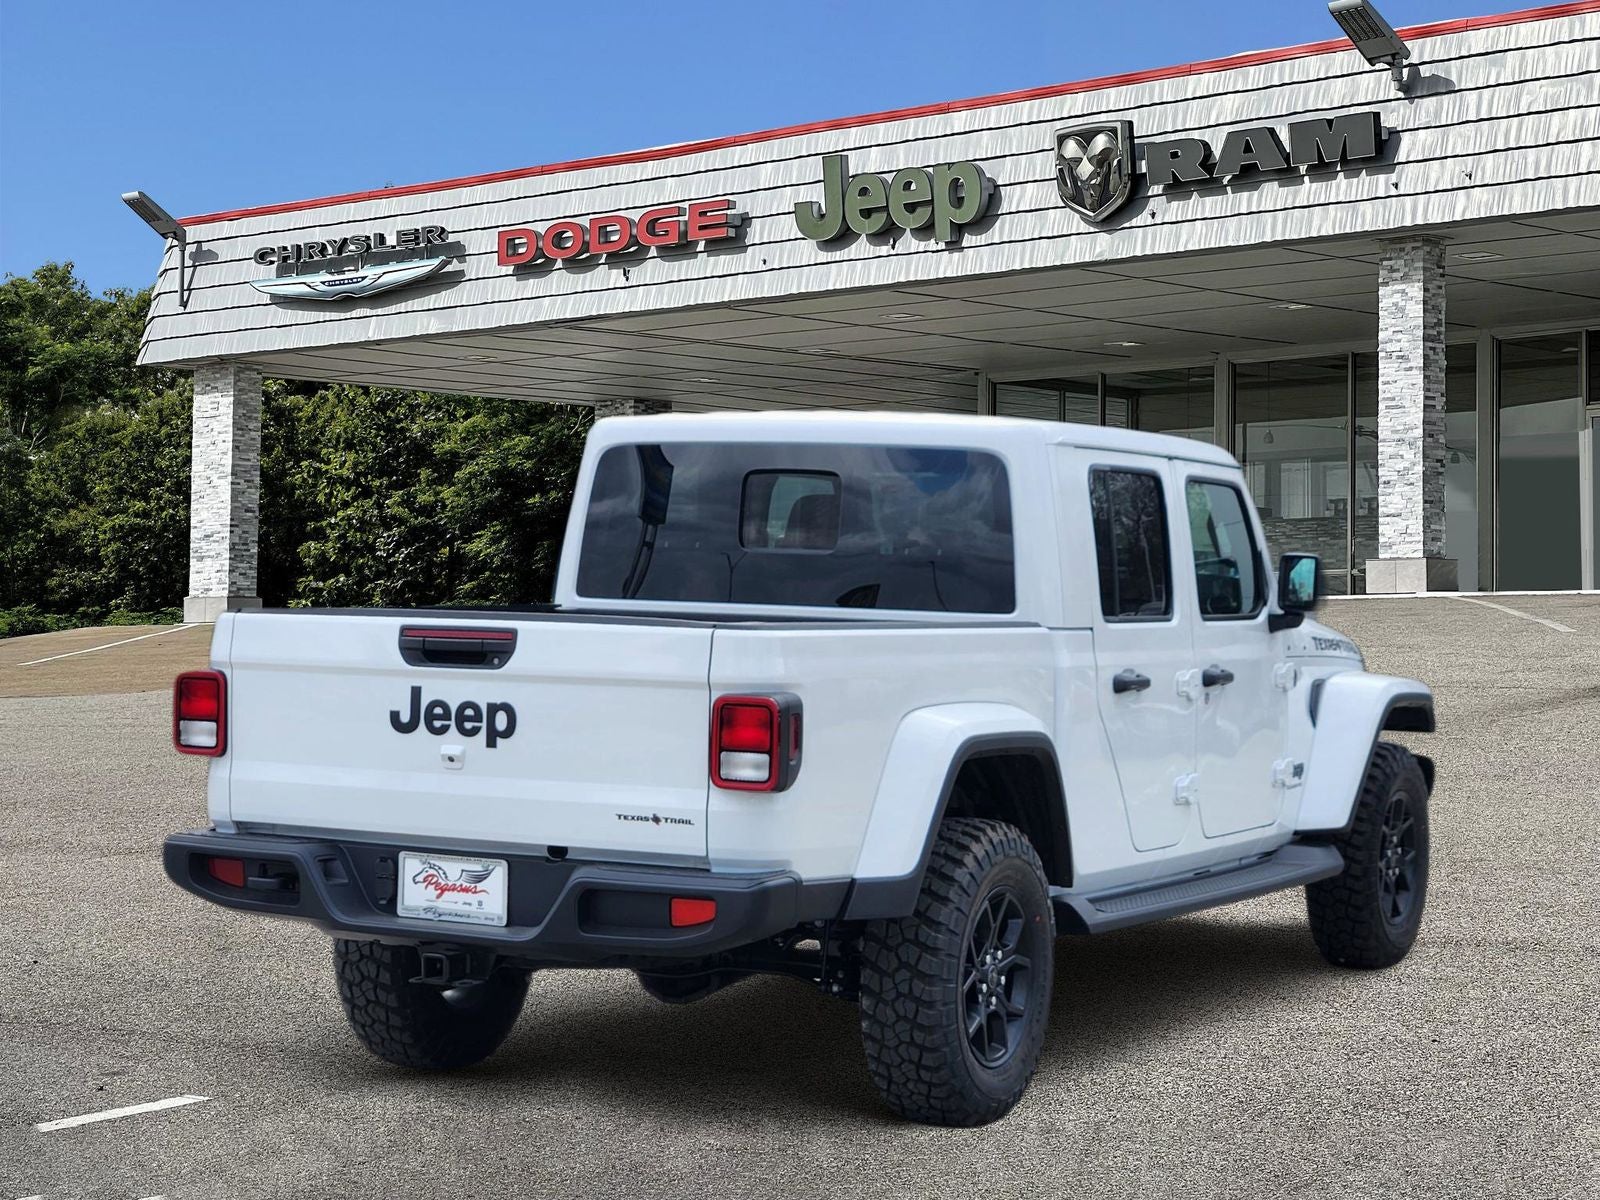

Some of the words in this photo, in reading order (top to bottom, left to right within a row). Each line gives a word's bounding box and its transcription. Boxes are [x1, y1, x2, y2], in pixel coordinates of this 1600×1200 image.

[1145, 111, 1380, 186] RAM
[794, 154, 987, 242] Jeep
[254, 225, 447, 266] CHRYSLER
[497, 199, 734, 266] DODGE
[325, 277, 363, 286] CHRYSLER
[389, 685, 517, 748] Jeep
[616, 813, 650, 822] TEXAS
[662, 817, 695, 826] TRAIL
[423, 873, 489, 899] Pegasus
